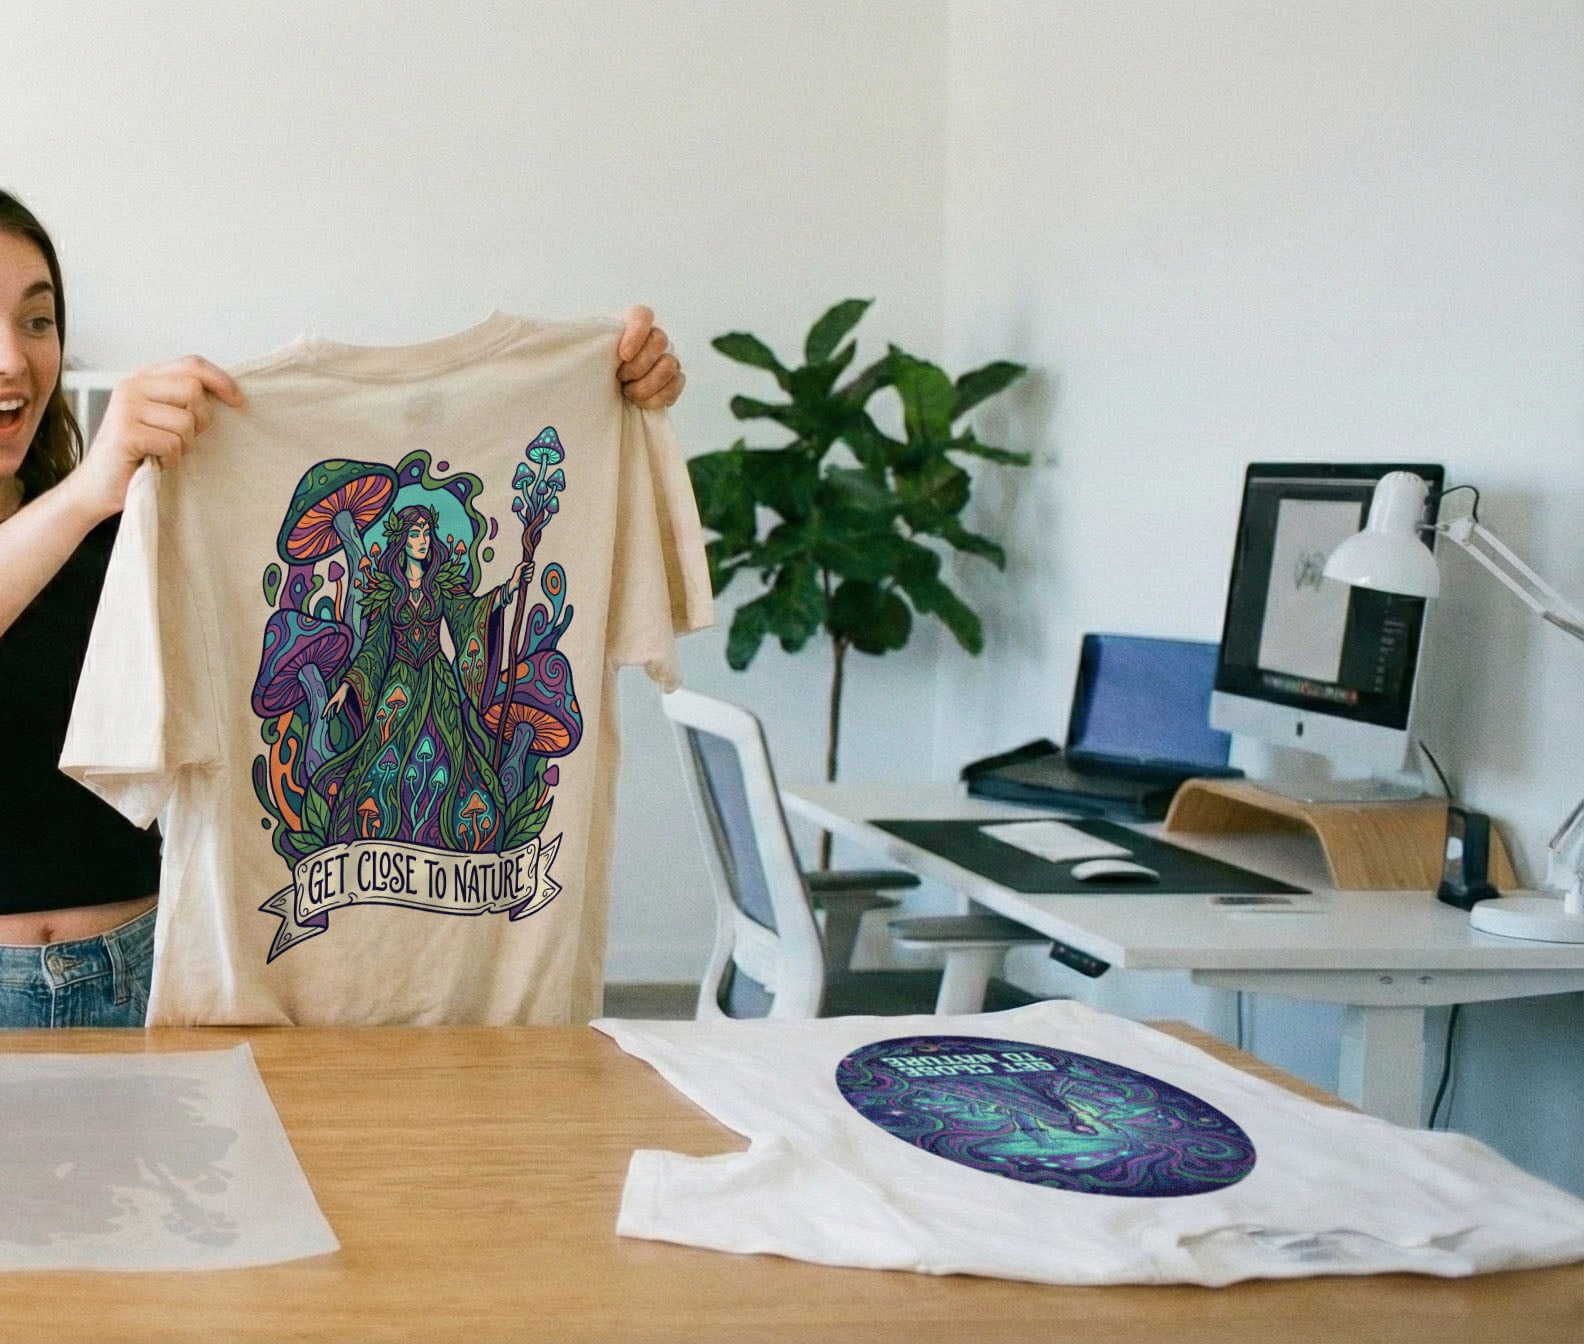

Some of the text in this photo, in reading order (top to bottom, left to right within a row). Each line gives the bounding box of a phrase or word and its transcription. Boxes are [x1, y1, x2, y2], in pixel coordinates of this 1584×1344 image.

[308, 850, 525, 904] GET CLOSE TO NATURE
[880, 1052, 1045, 1067] TO NATURE
[897, 1061, 1057, 1078] GET CLOSE
